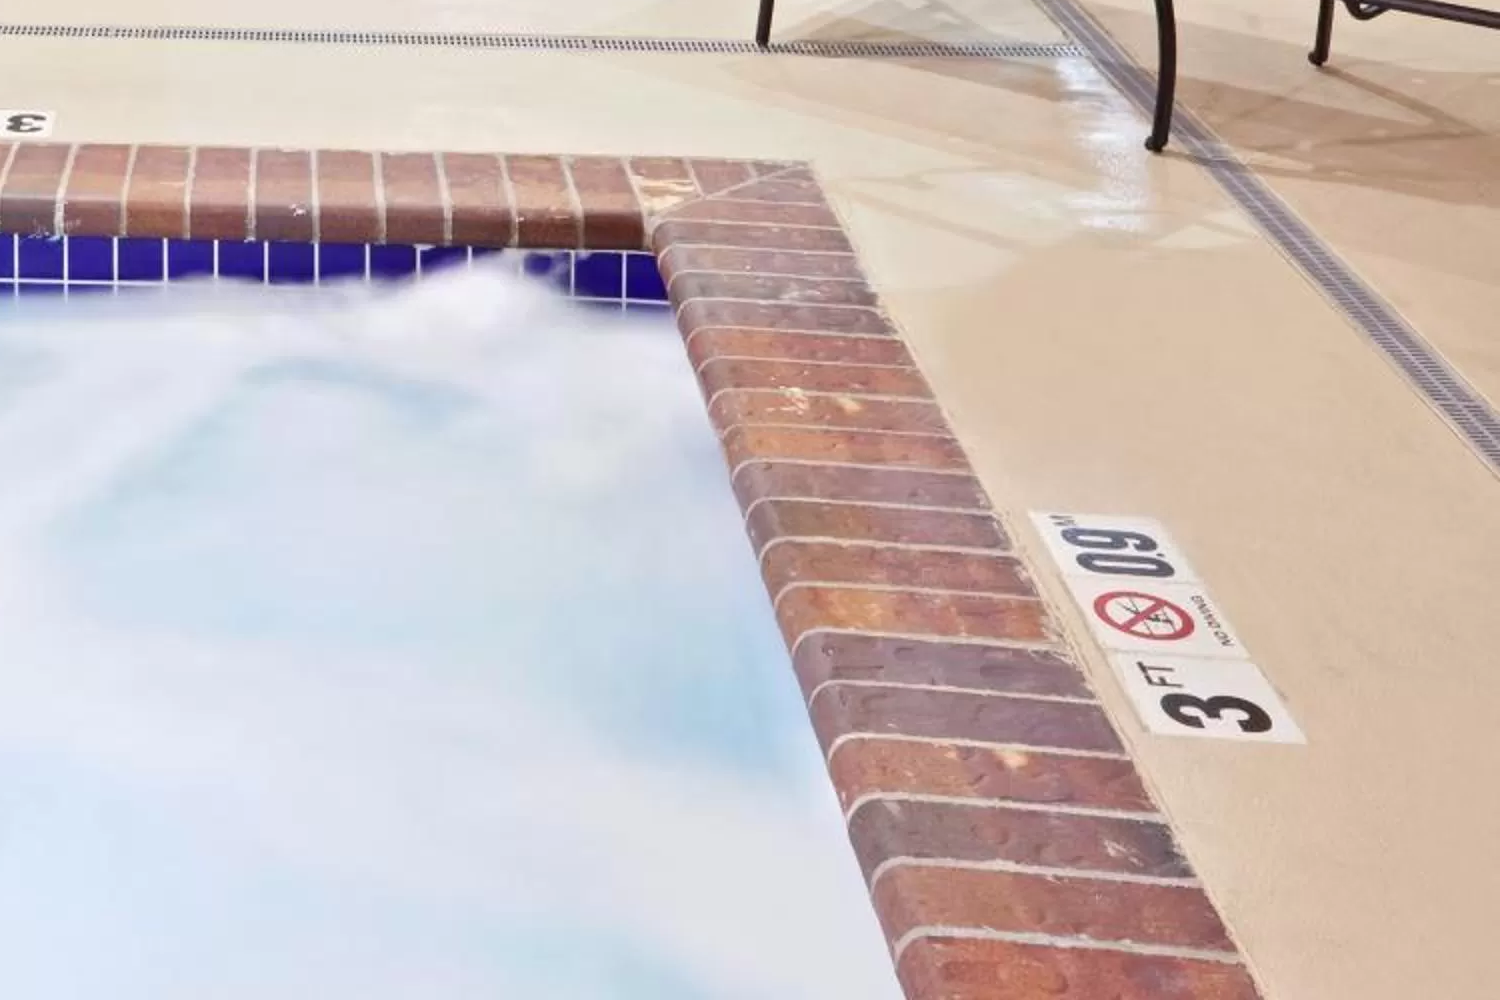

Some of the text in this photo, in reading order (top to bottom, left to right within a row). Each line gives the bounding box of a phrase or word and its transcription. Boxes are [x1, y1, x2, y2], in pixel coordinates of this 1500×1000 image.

[6, 113, 47, 133] 3
[1061, 527, 1175, 578] 0.9
[1191, 594, 1221, 629] DIVING
[1136, 660, 1273, 733] 3 FT
